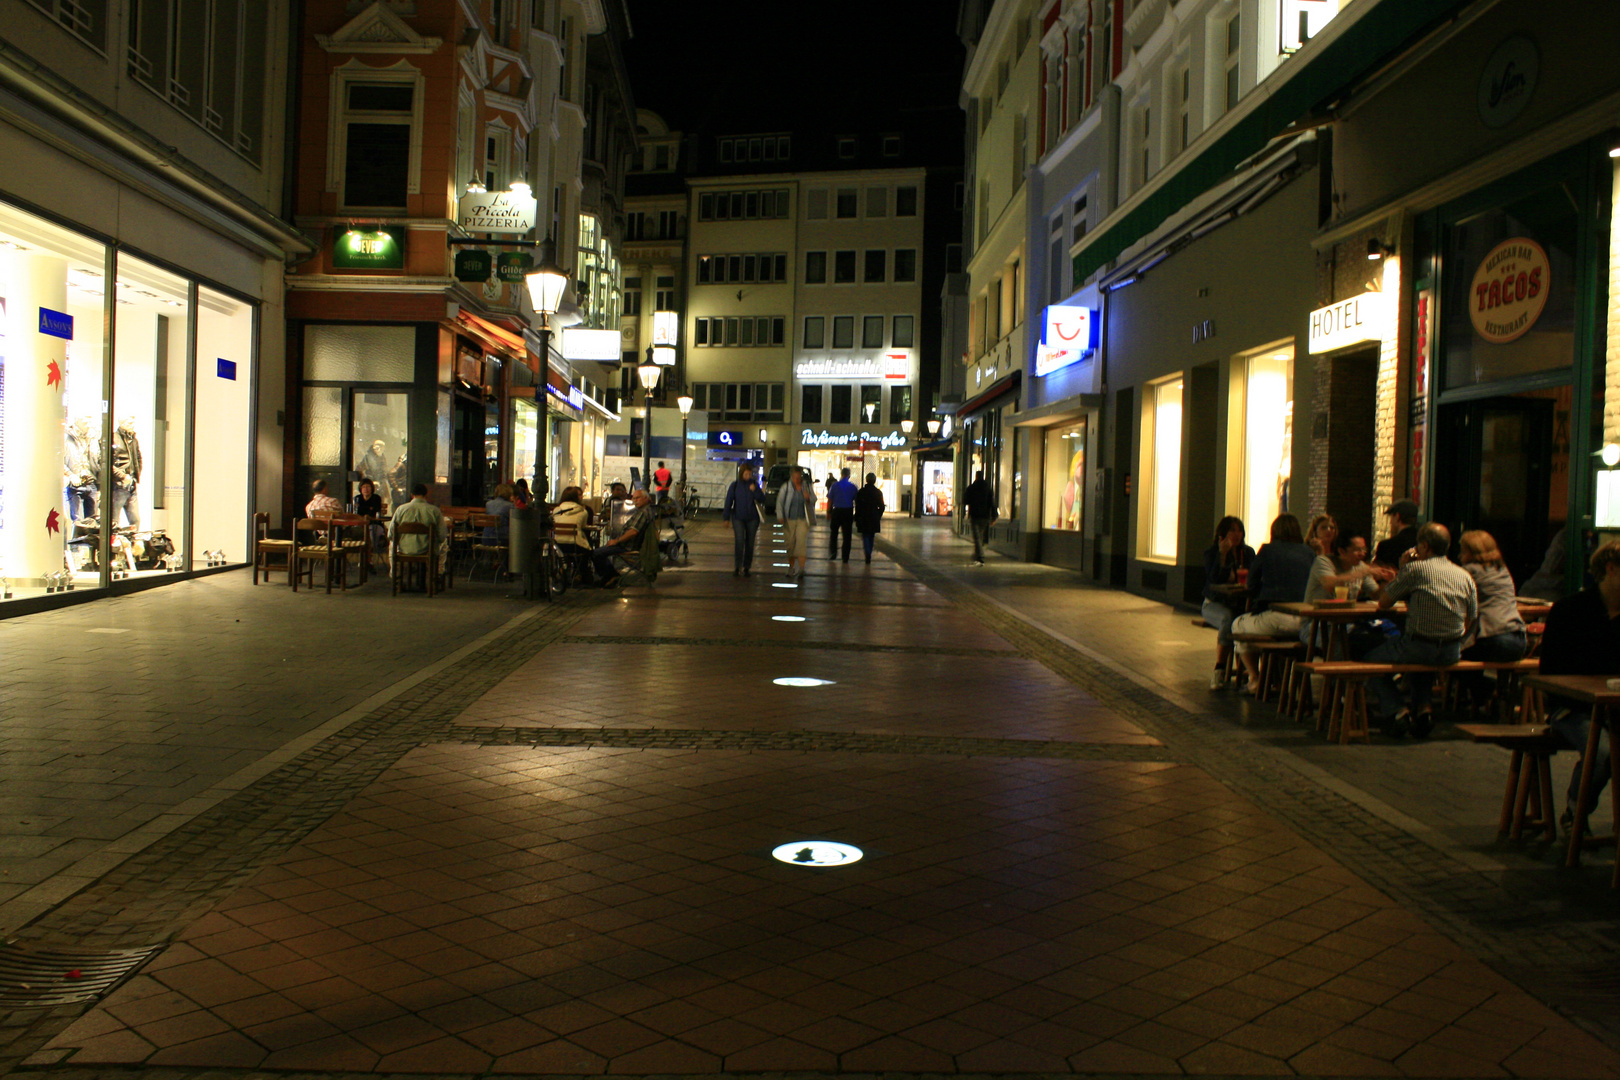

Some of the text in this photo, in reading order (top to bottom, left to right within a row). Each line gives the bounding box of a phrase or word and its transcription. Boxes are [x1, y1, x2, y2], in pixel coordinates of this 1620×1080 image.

[472, 203, 520, 217] Piccola
[491, 192, 509, 206] La
[464, 217, 529, 228] PIZZERIA
[356, 239, 384, 254] JEVE
[1485, 245, 1533, 274] MEXICAN BAR
[1476, 265, 1542, 313] TACOS
[1312, 299, 1363, 340] HOTEL
[1485, 311, 1529, 336] RESTAURANT
[1416, 298, 1428, 394] HAPPY
[1412, 431, 1423, 506] HOUR
